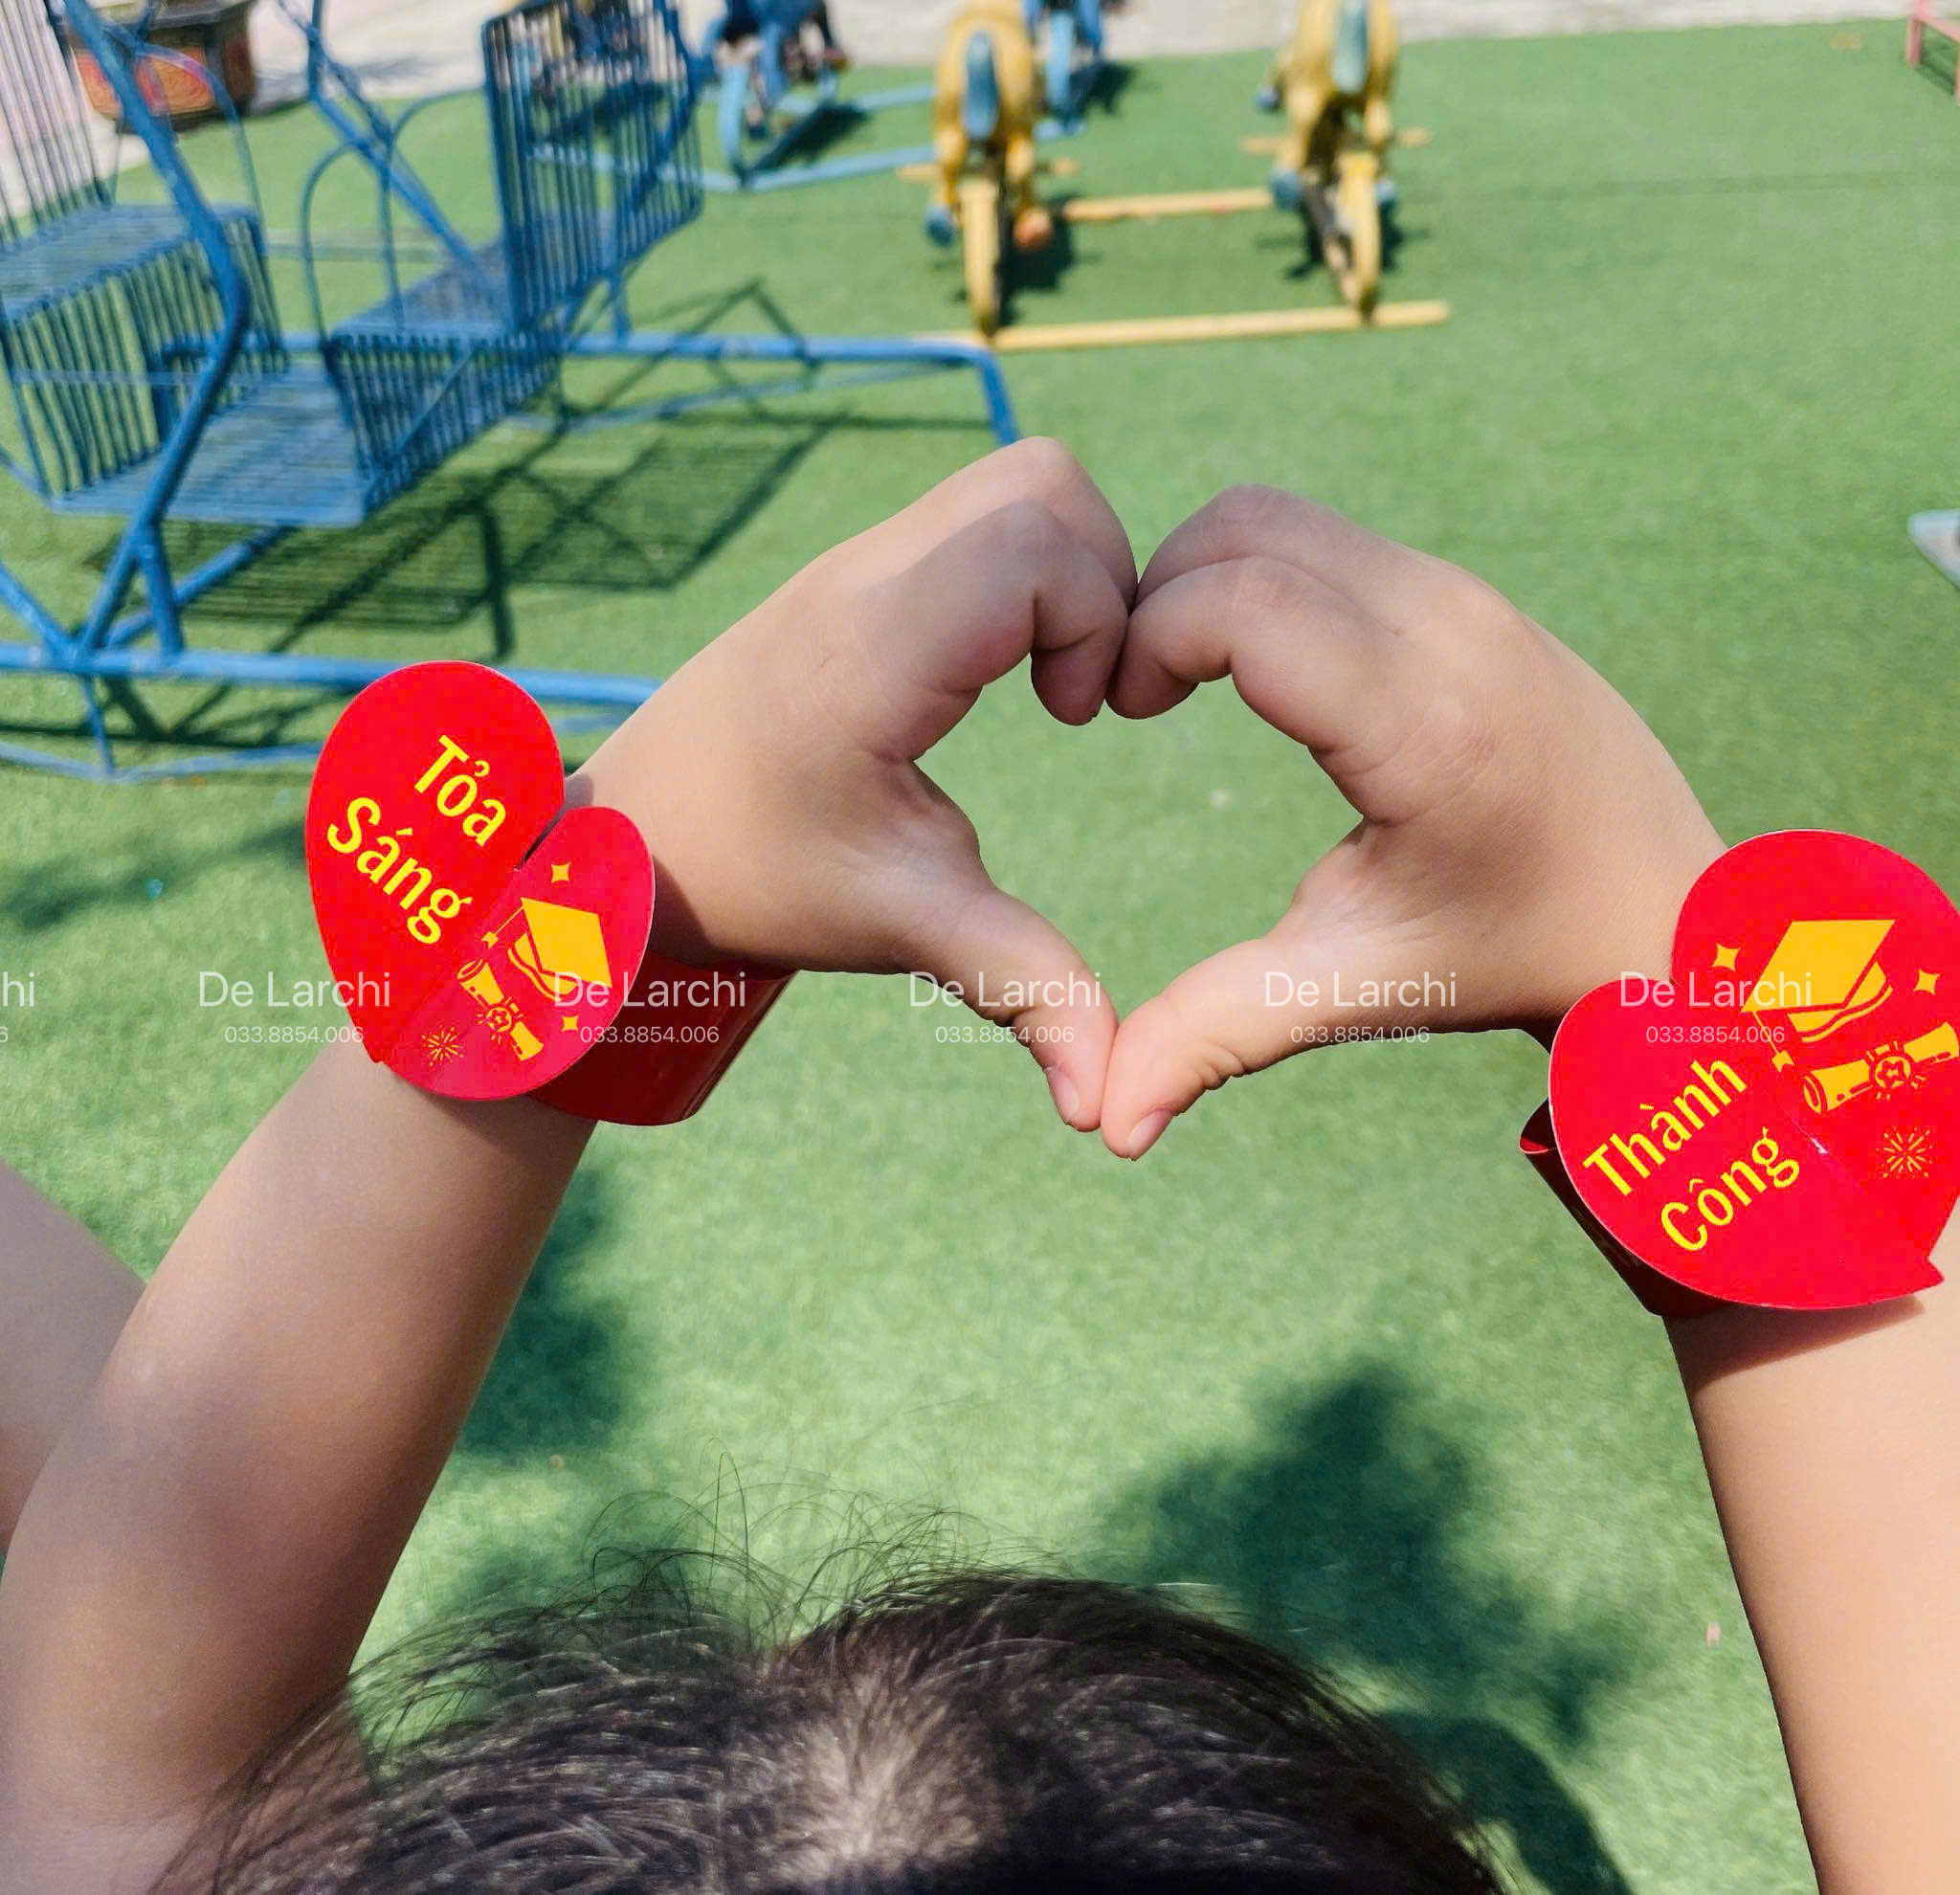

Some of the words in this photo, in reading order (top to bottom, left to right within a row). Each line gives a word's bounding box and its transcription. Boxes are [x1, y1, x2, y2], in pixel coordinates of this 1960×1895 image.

[413, 734, 507, 847] Tỏa
[326, 796, 473, 946] Sáng
[1583, 1059, 1748, 1196] Thành
[1660, 1126, 1800, 1252] Công
